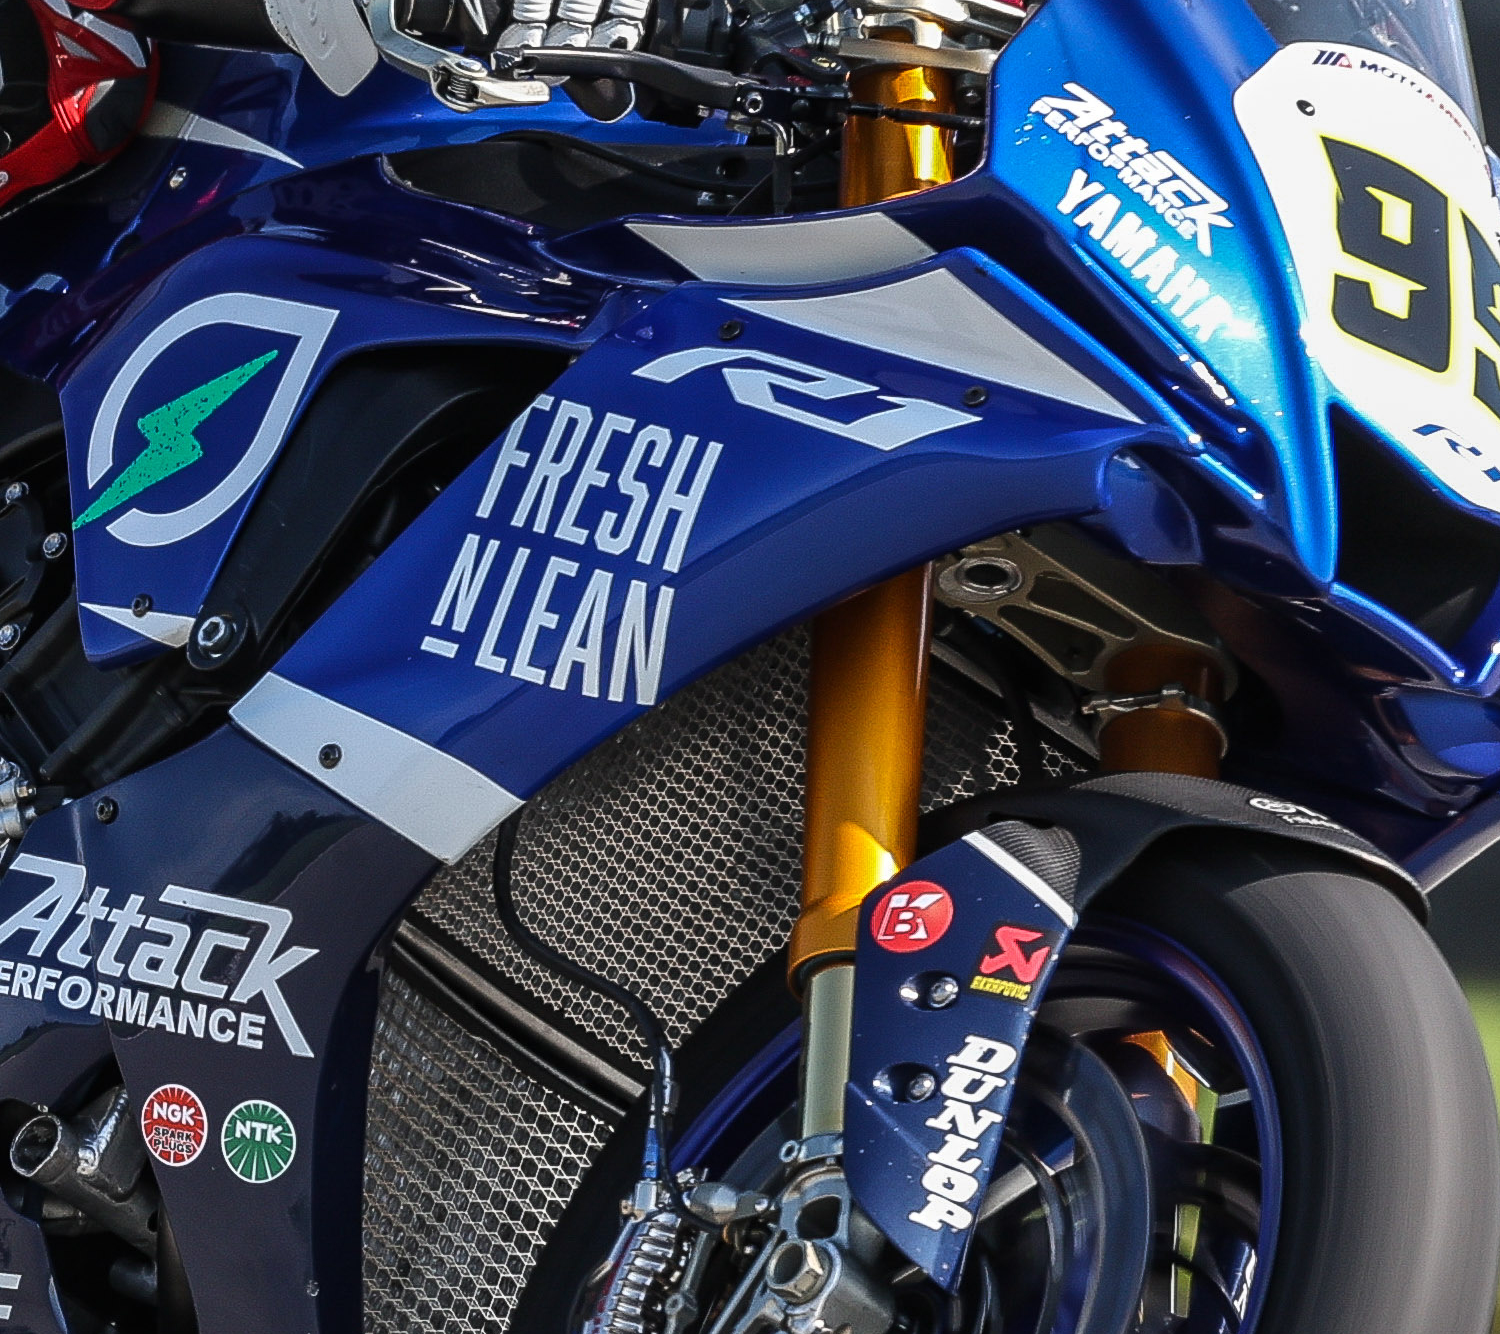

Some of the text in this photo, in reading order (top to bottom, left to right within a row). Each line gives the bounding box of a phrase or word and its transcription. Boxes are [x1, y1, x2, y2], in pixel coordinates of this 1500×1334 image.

[1056, 168, 1232, 343] YAMAHA
[477, 393, 724, 575] FRESH
[152, 1101, 195, 1126] NGK
[153, 1126, 192, 1142] SPARK
[235, 1120, 283, 1145] NTK
[908, 1034, 1018, 1234] DUNLOP
[153, 1140, 193, 1154] PLUGS
